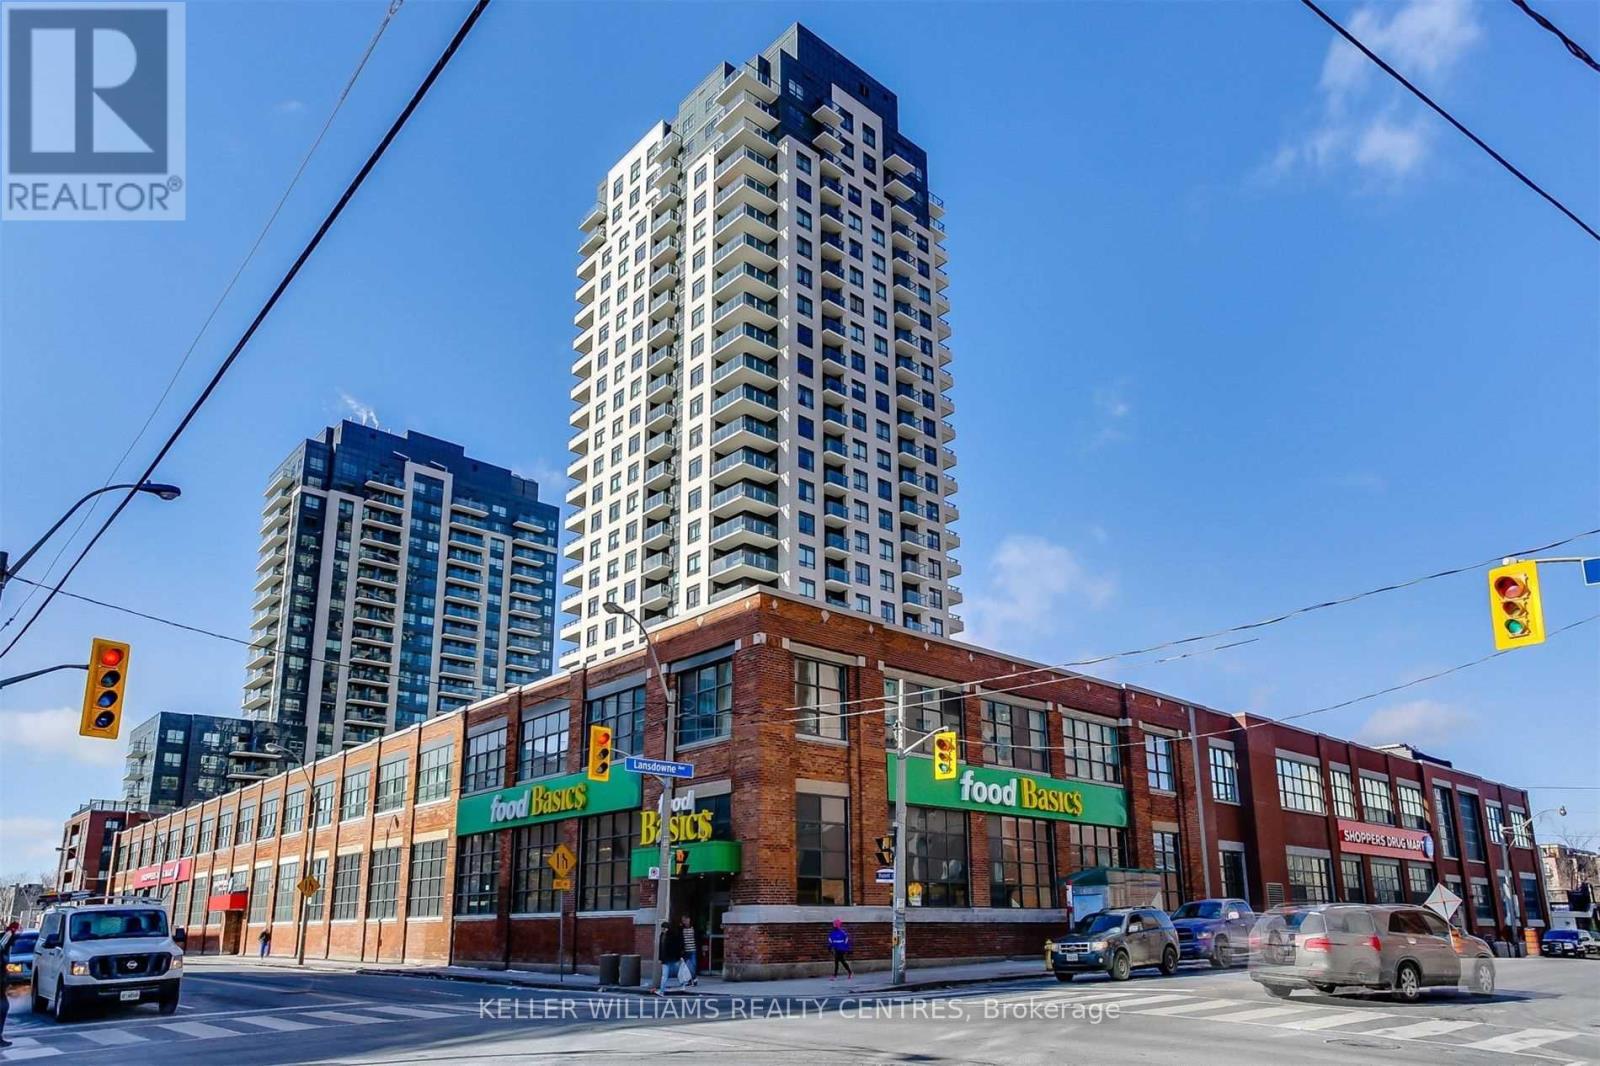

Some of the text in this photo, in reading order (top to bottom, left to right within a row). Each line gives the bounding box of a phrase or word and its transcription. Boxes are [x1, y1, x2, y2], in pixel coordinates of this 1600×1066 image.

[633, 759, 676, 774] Lansdowne
[490, 783, 587, 823] food Basics
[658, 790, 695, 814] fod
[960, 770, 1083, 816] food Basics
[1344, 829, 1425, 852] SHOPPERS DRUG MART
